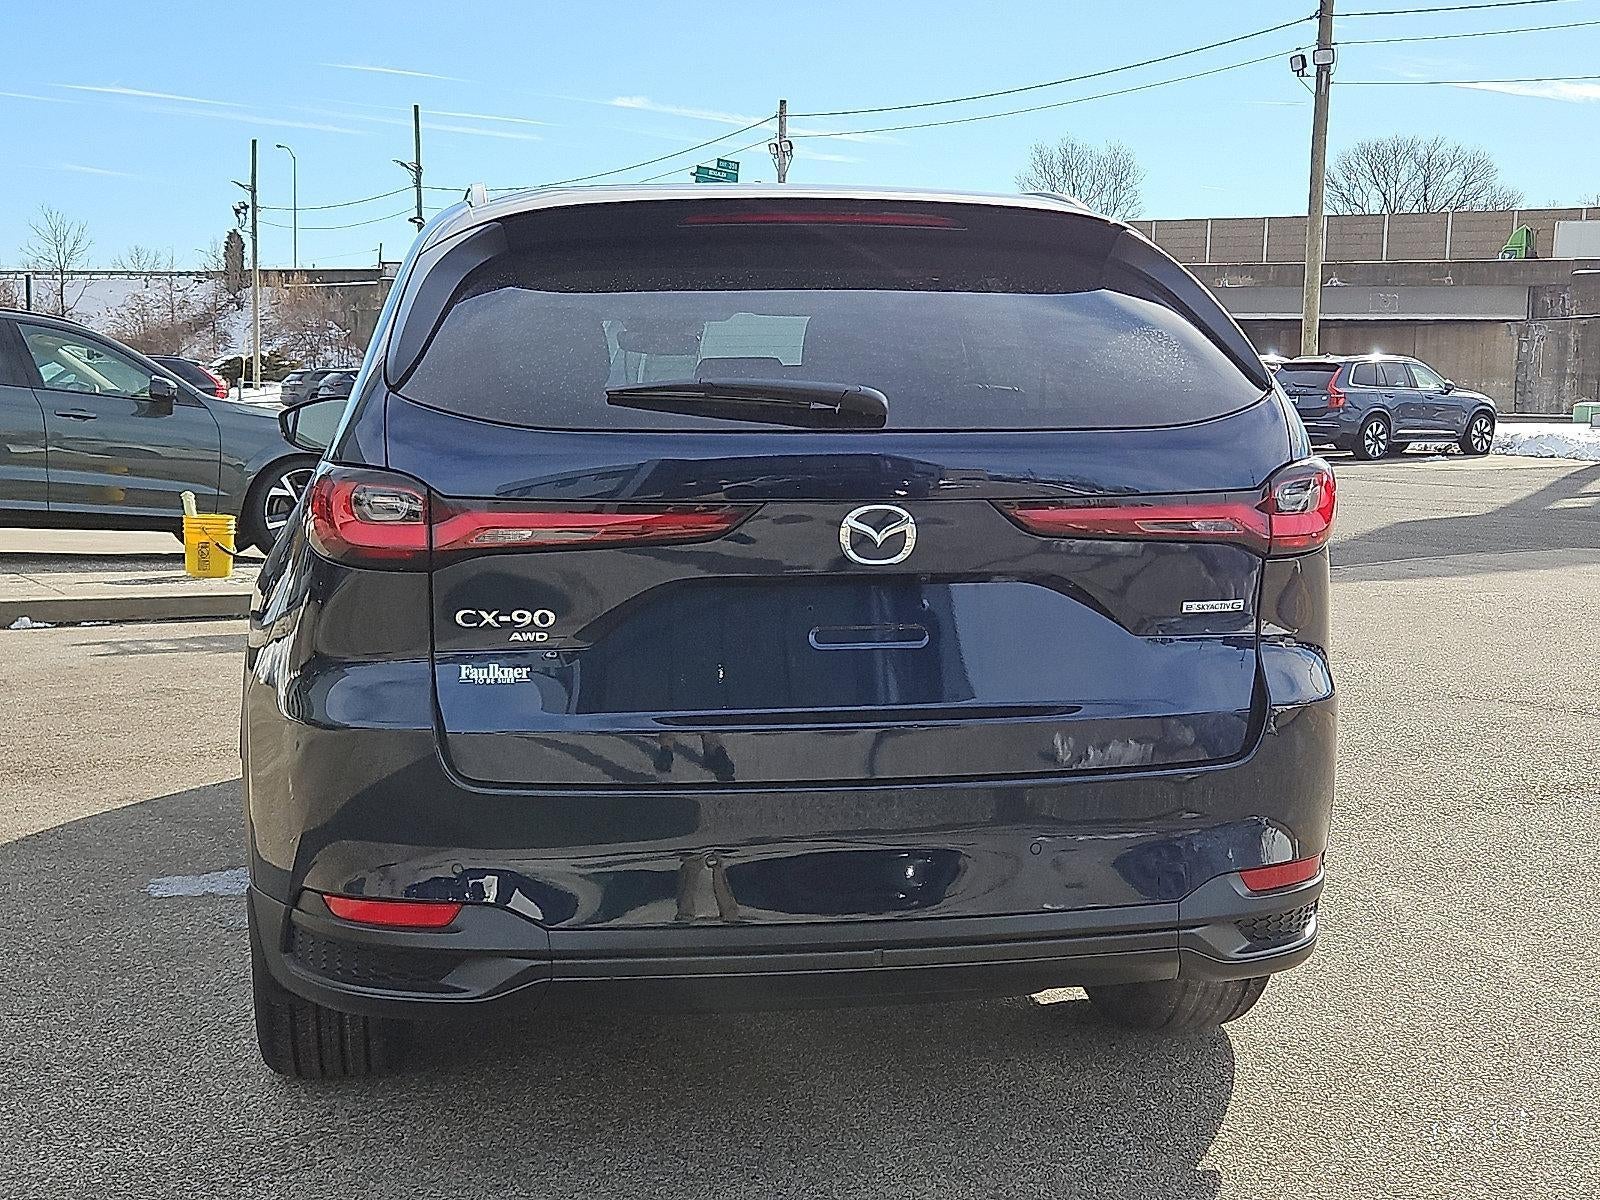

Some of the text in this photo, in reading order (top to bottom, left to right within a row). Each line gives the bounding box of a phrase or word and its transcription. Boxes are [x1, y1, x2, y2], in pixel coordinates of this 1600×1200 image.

[455, 609, 556, 628] CX-90
[508, 632, 548, 642] AWD
[459, 663, 531, 680] Faulkner
